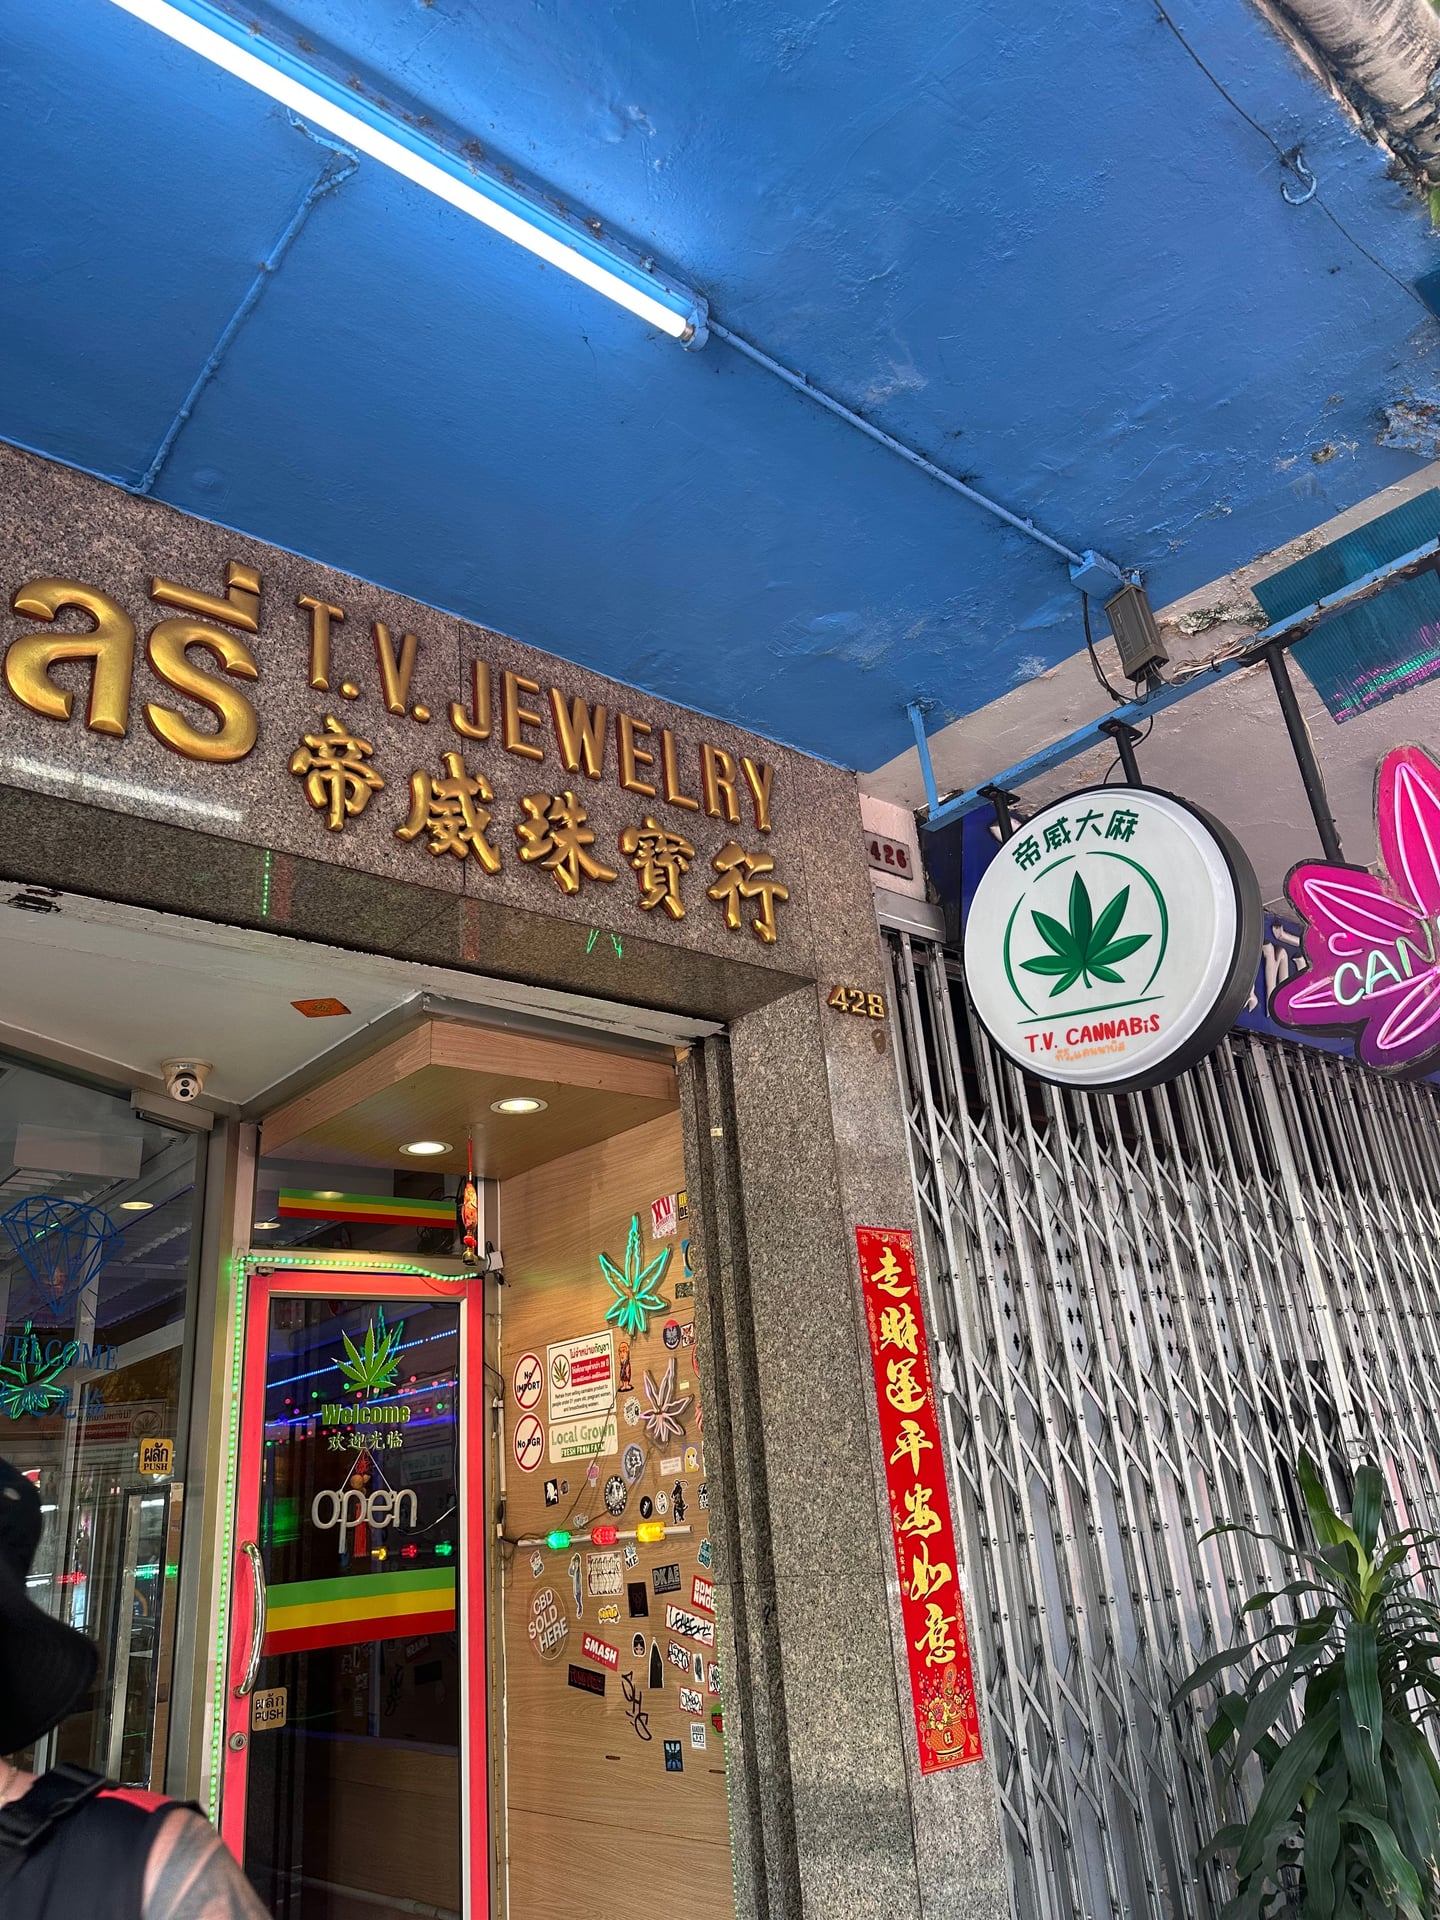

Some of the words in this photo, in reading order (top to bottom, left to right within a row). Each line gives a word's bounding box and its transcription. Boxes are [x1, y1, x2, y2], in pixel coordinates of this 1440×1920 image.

[297, 593, 431, 723] T.V.
[451, 660, 774, 832] JEWELRY
[289, 714, 790, 943] 帝威珠寶行
[1012, 809, 1139, 871] 帝威大麻
[828, 985, 885, 1019] 428
[1024, 1031, 1058, 1053] T.V.
[321, 1403, 411, 1425] Welcome
[327, 1430, 403, 1451] 欢迎光临
[517, 1440, 526, 1449] No
[551, 1425, 578, 1445] Local
[580, 1422, 615, 1441] Grown
[144, 1442, 169, 1462] ผลัก
[144, 1463, 168, 1471] PUSH
[312, 1489, 418, 1554] open
[533, 1589, 554, 1615] CBD
[528, 1604, 558, 1639] SOLD
[539, 1616, 569, 1653] HERE
[584, 1637, 617, 1664] SMASH
[256, 1693, 284, 1710] ผลัก
[256, 1708, 284, 1723] PUSH
